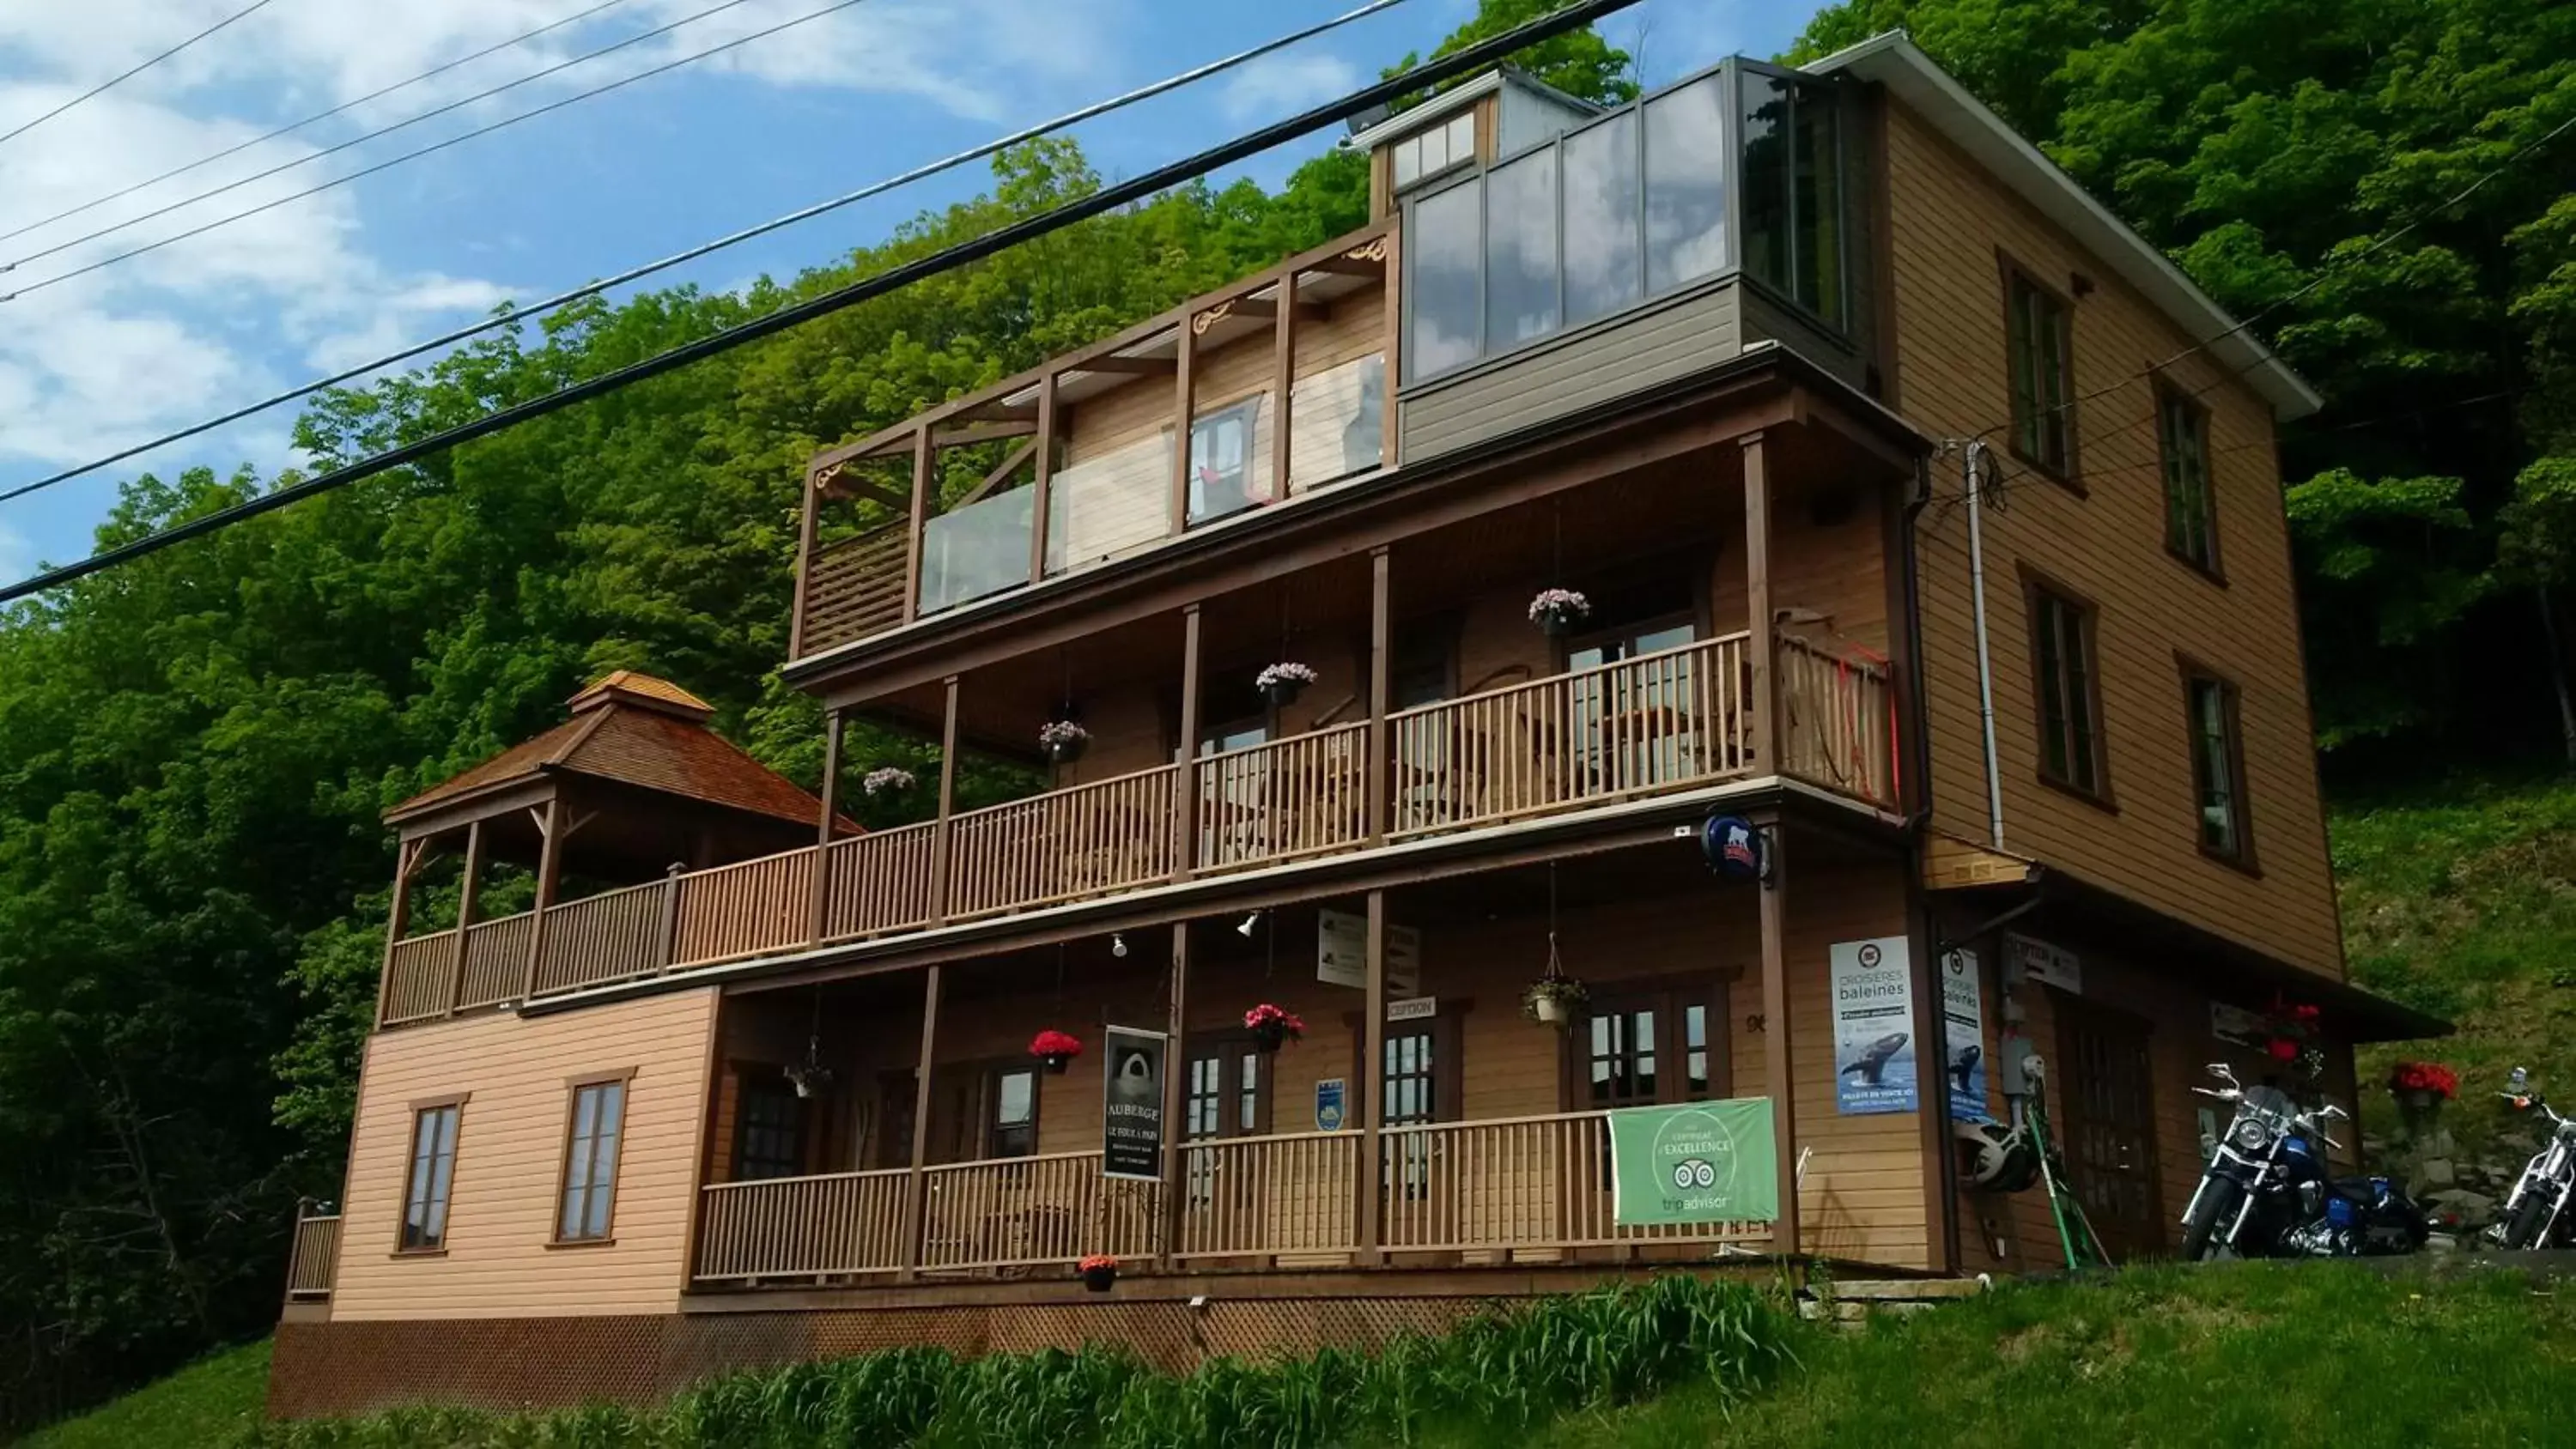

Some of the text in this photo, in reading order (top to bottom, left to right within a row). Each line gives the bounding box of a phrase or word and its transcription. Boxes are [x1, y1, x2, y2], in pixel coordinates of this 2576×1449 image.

[1840, 984, 1904, 1000] baleines
[1108, 1103, 1159, 1122] AUBERGE
[1662, 1196, 1728, 1214] tripadvisor
